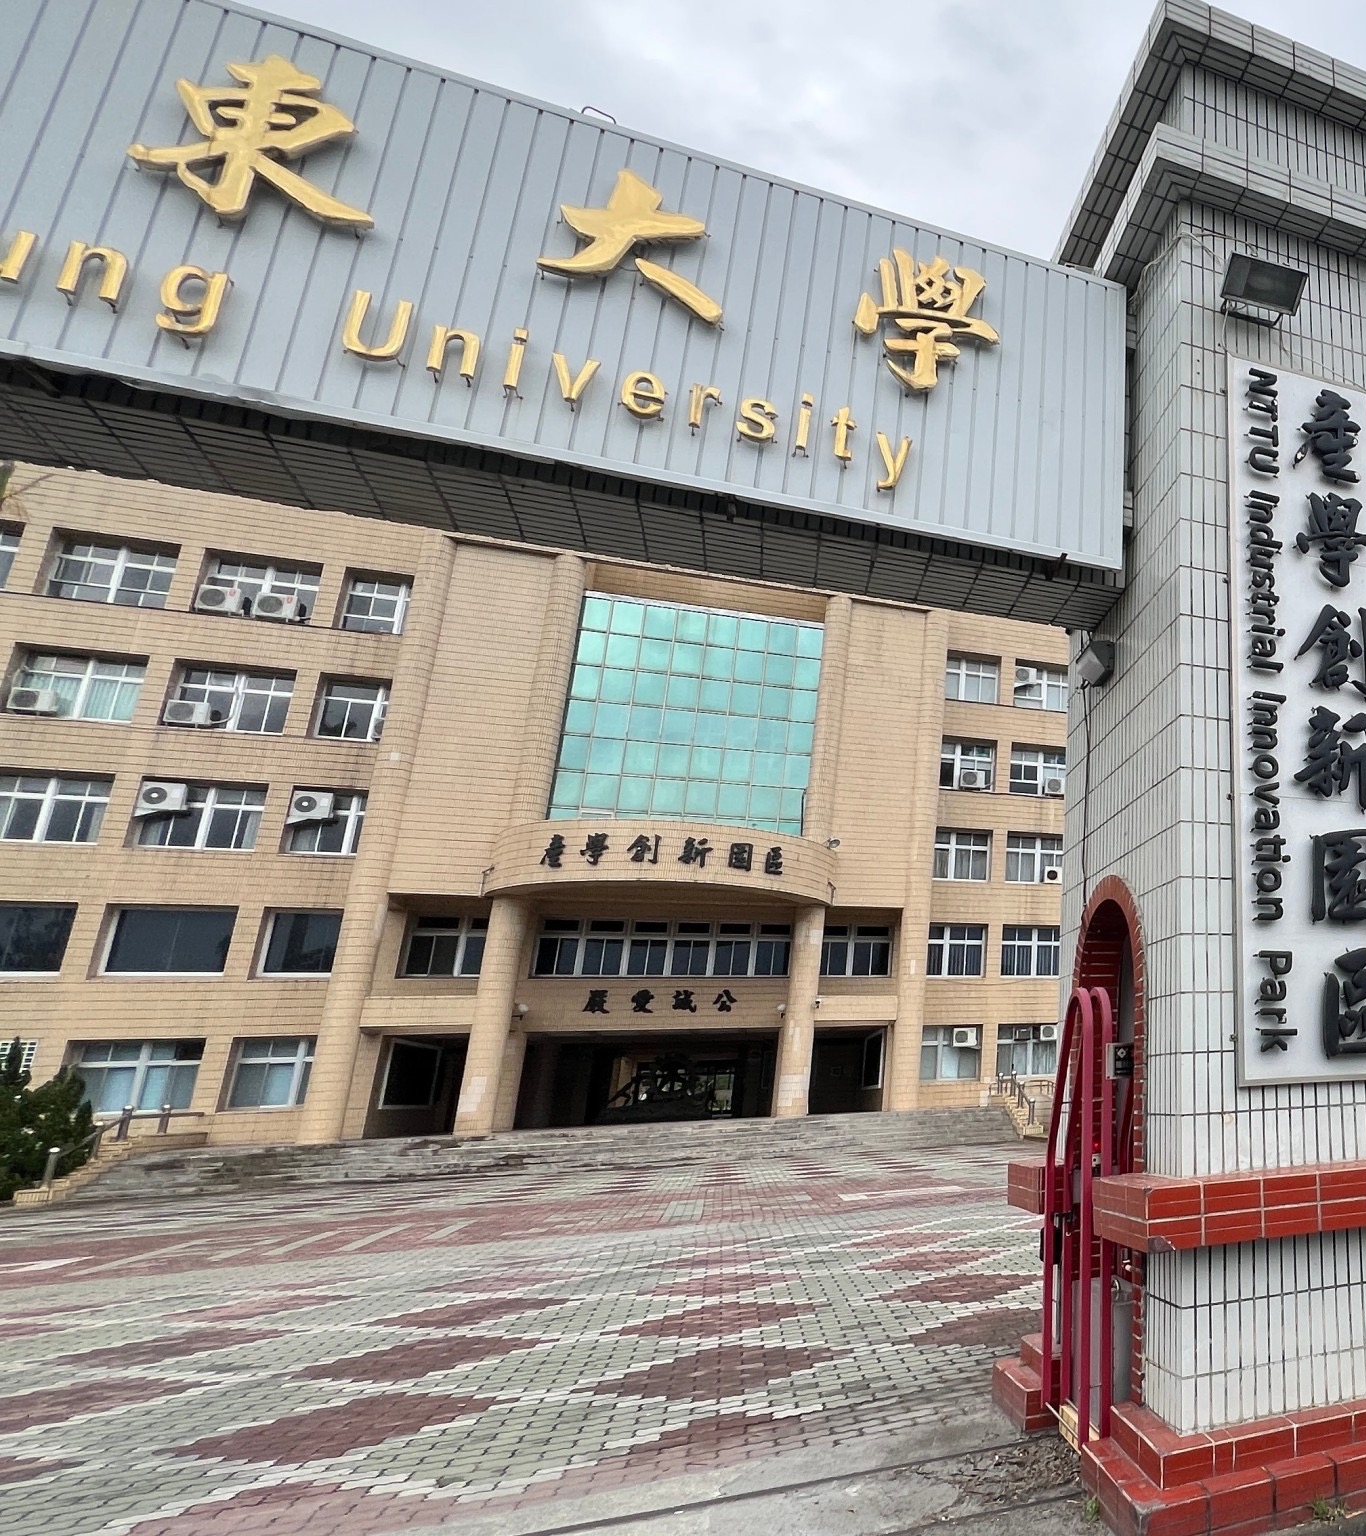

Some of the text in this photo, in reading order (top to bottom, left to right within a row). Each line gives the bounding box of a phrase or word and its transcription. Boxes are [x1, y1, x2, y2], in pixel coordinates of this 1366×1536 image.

[343, 289, 913, 491] University
[1248, 367, 1298, 1052] NTTU Industrial Innovation Park
[540, 832, 783, 876] 產學創新園區
